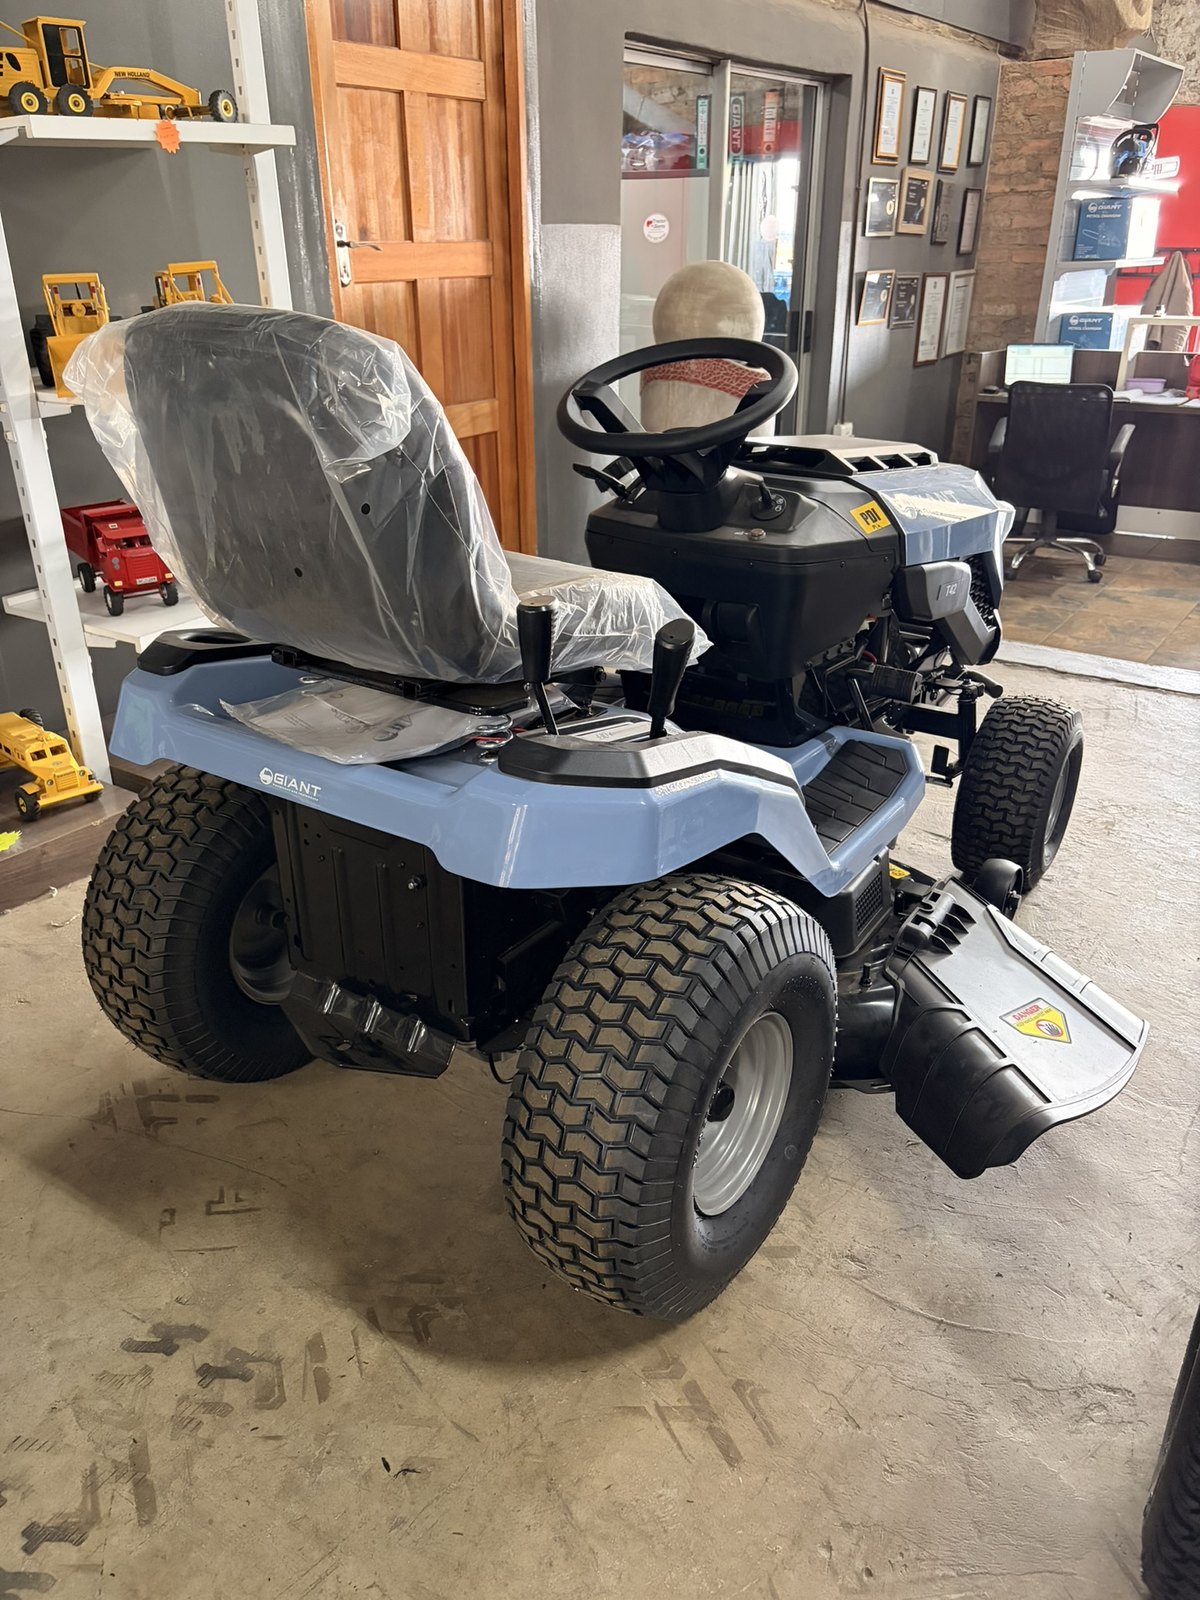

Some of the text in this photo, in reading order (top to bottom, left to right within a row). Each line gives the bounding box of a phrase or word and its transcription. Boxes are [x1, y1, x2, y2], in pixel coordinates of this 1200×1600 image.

[732, 103, 741, 148] GIANT
[859, 507, 881, 526] PDI
[273, 772, 322, 797] GIANT
[1012, 1004, 1041, 1021] DANGER
